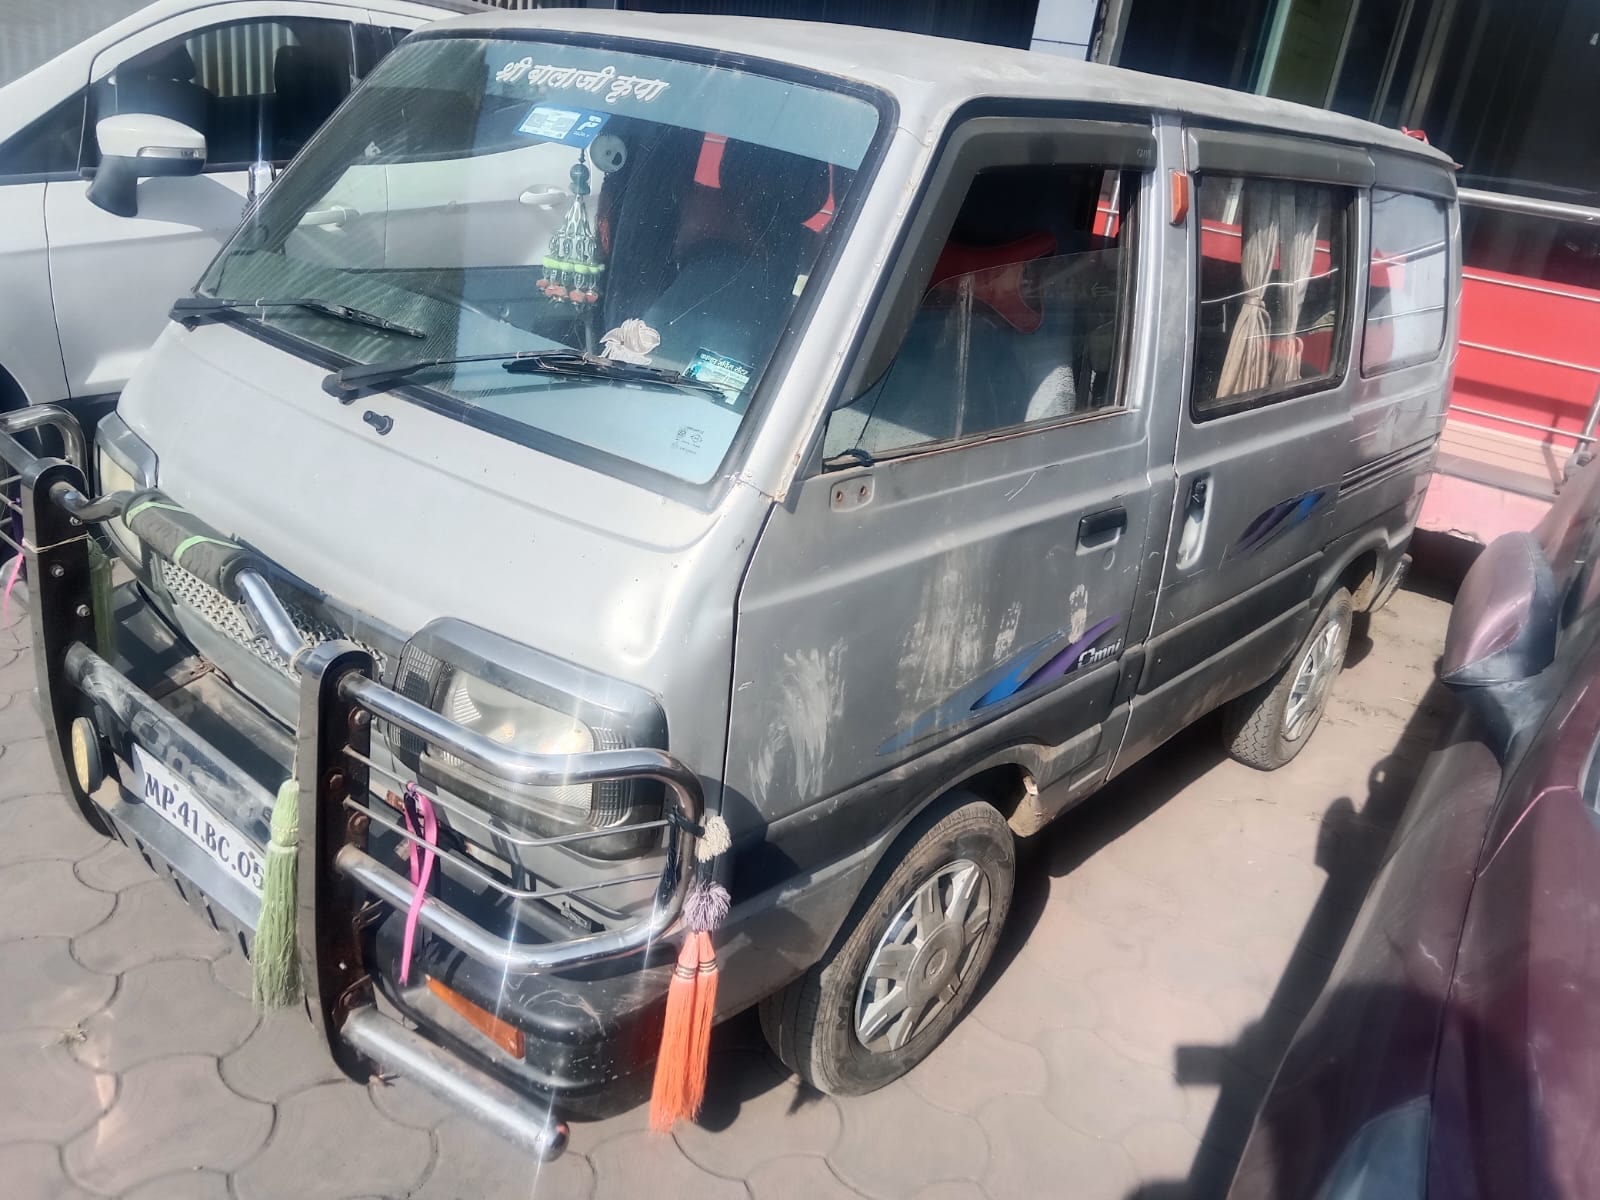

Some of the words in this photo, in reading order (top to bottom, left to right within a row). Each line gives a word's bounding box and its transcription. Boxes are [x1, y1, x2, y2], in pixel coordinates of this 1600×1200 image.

[496, 57, 533, 82] श्री
[528, 65, 616, 93] बालाजी
[1078, 638, 1122, 668] Omni
